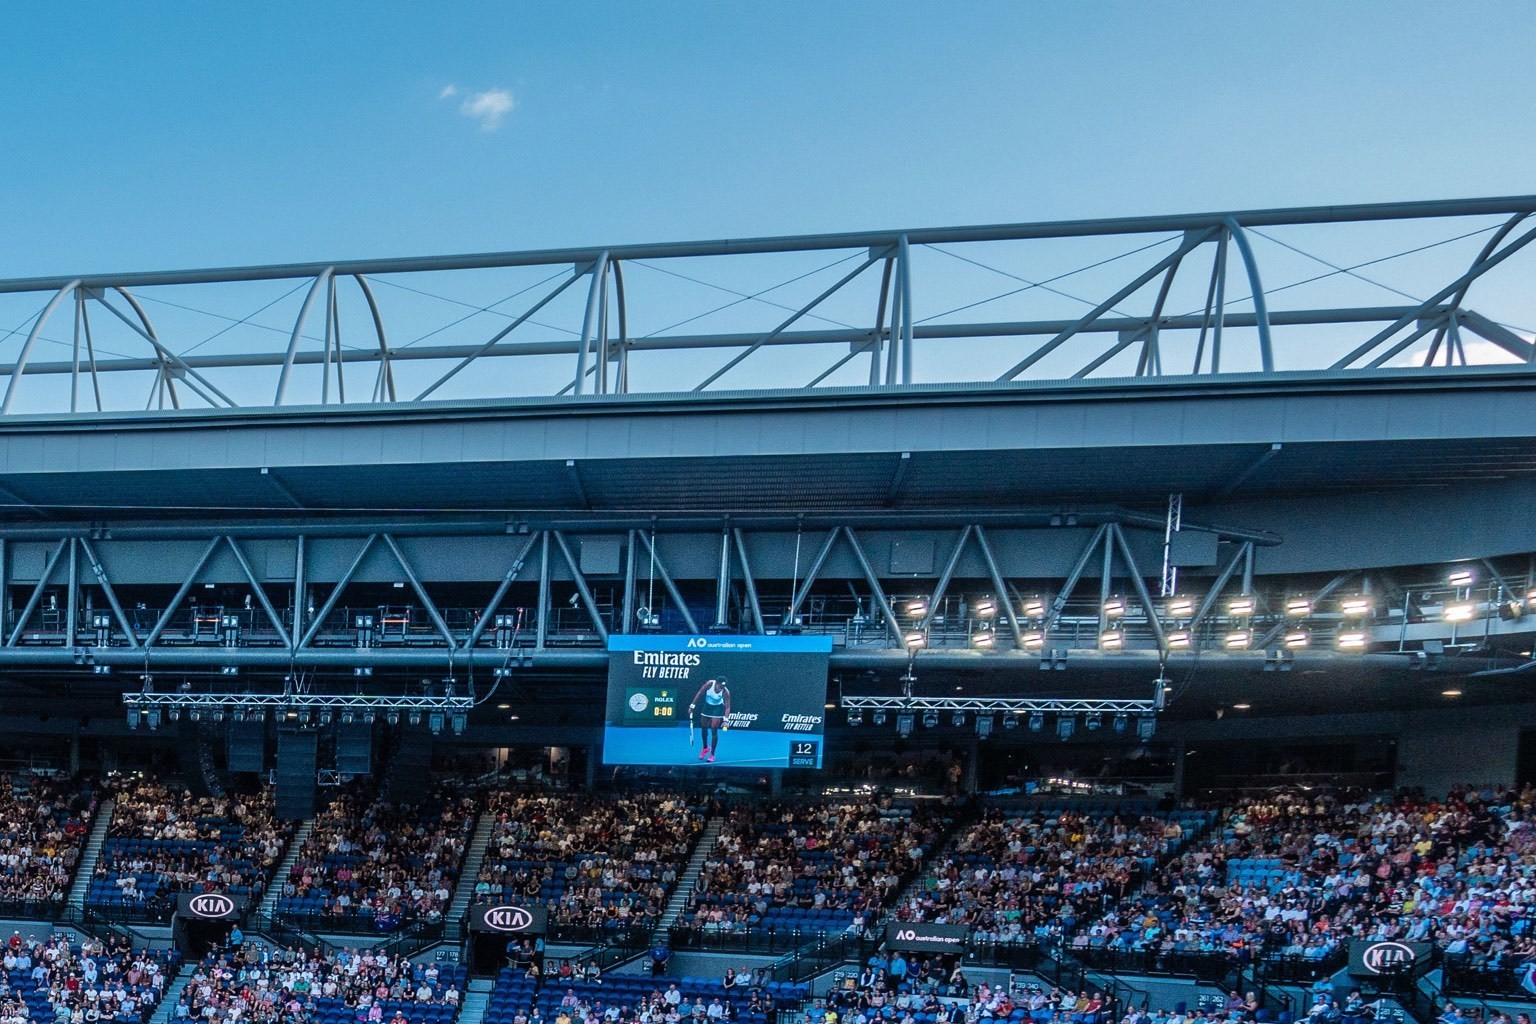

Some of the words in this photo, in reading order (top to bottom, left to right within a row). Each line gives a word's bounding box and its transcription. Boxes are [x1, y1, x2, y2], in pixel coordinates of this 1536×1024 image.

[688, 638, 706, 648] AO
[634, 650, 700, 666] Emirates
[643, 667, 657, 678] FLY
[659, 667, 689, 679] BETTER
[654, 707, 672, 716] 0:00
[728, 712, 758, 720] mirates
[782, 714, 822, 723] Emirates
[796, 743, 812, 754] 12
[197, 899, 226, 912] KIA
[492, 911, 524, 925] KIA
[896, 930, 915, 940] AO
[1372, 949, 1404, 966] KIA
